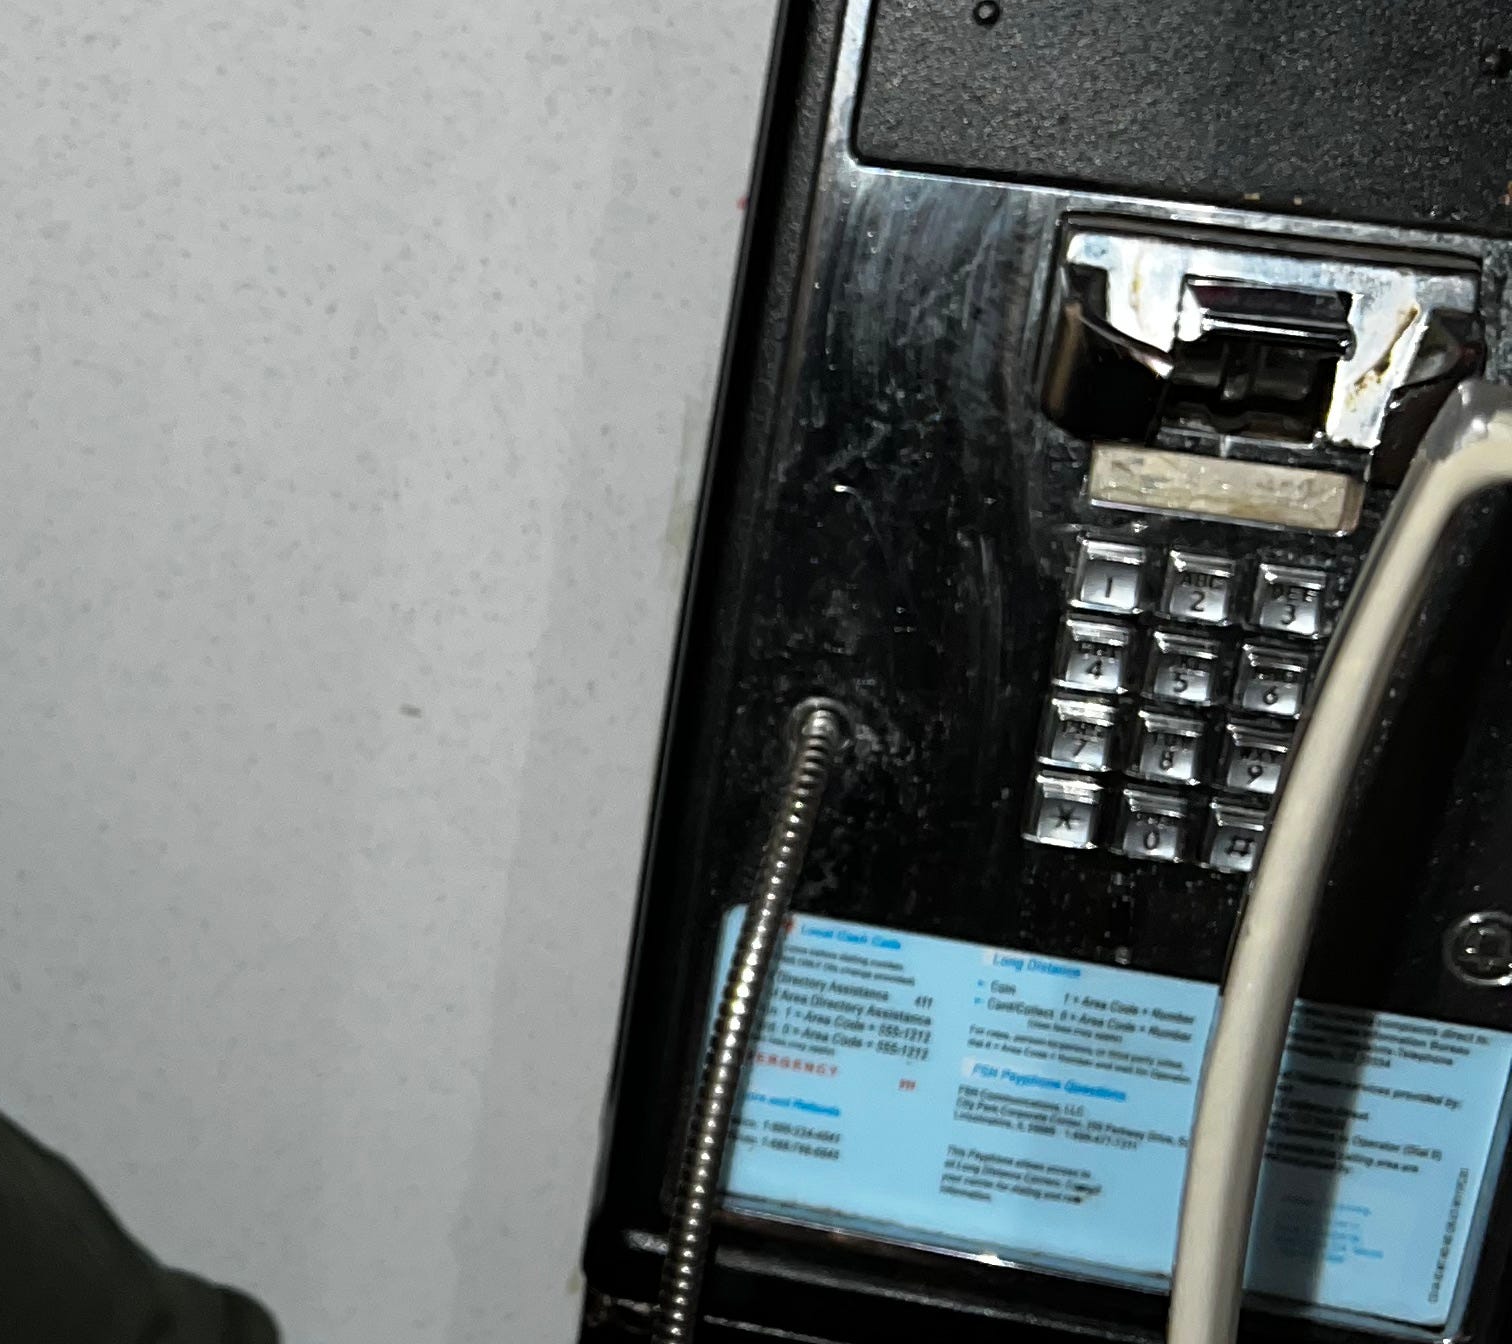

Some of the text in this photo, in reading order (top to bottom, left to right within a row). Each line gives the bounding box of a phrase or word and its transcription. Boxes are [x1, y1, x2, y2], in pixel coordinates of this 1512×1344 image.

[1190, 591, 1206, 612] 2
[1281, 604, 1295, 624] 3
[1087, 660, 1102, 679] 4
[1173, 673, 1187, 692] 5
[1263, 686, 1278, 704] 6
[1248, 765, 1263, 783] 9
[993, 953, 1081, 978] Long Distance
